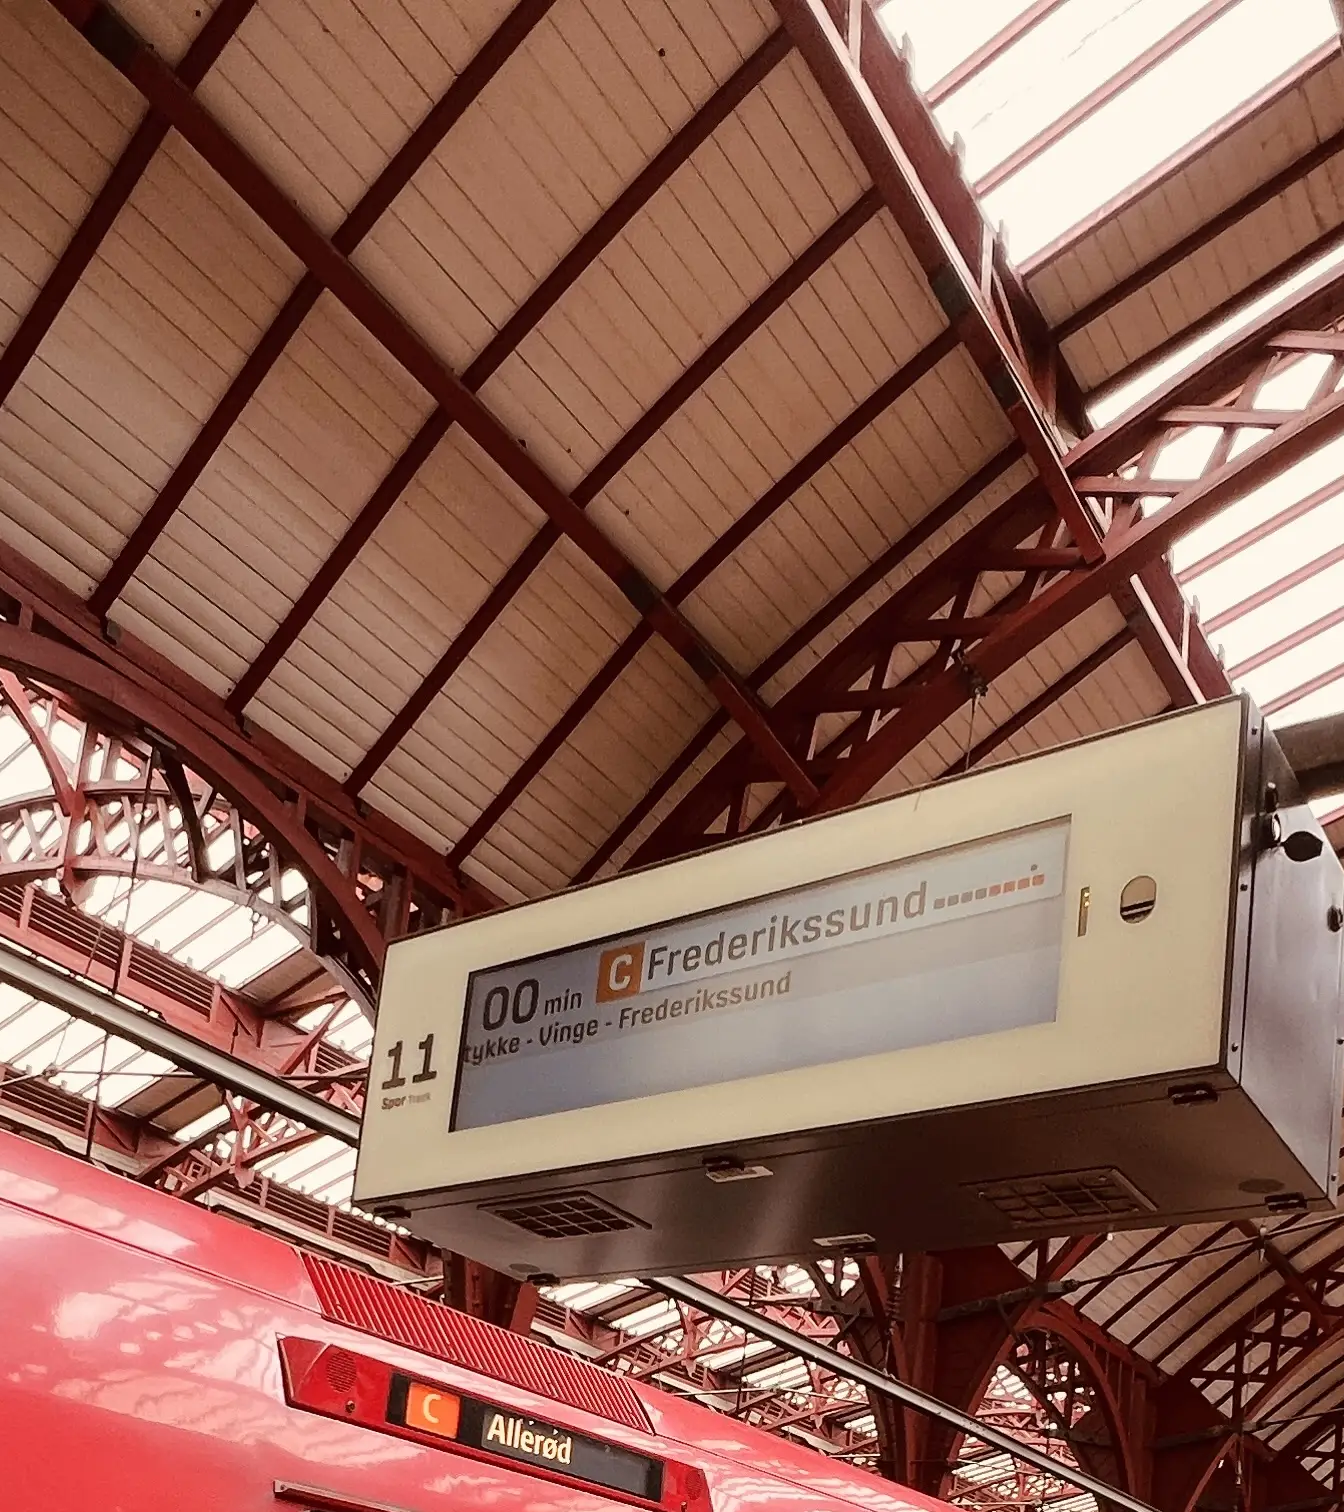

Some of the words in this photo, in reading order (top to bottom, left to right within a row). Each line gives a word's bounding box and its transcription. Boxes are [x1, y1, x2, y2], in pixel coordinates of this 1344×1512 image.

[482, 977, 539, 1031] 00
[544, 988, 583, 1016] min
[608, 953, 633, 991] C
[647, 880, 929, 981] Frederikssund
[539, 1016, 599, 1047] Vinge
[619, 971, 792, 1029] Frederikssund
[381, 1033, 438, 1090] 11
[381, 1096, 407, 1111] Spor
[422, 1393, 442, 1424] C
[486, 1413, 572, 1465] Allerød
